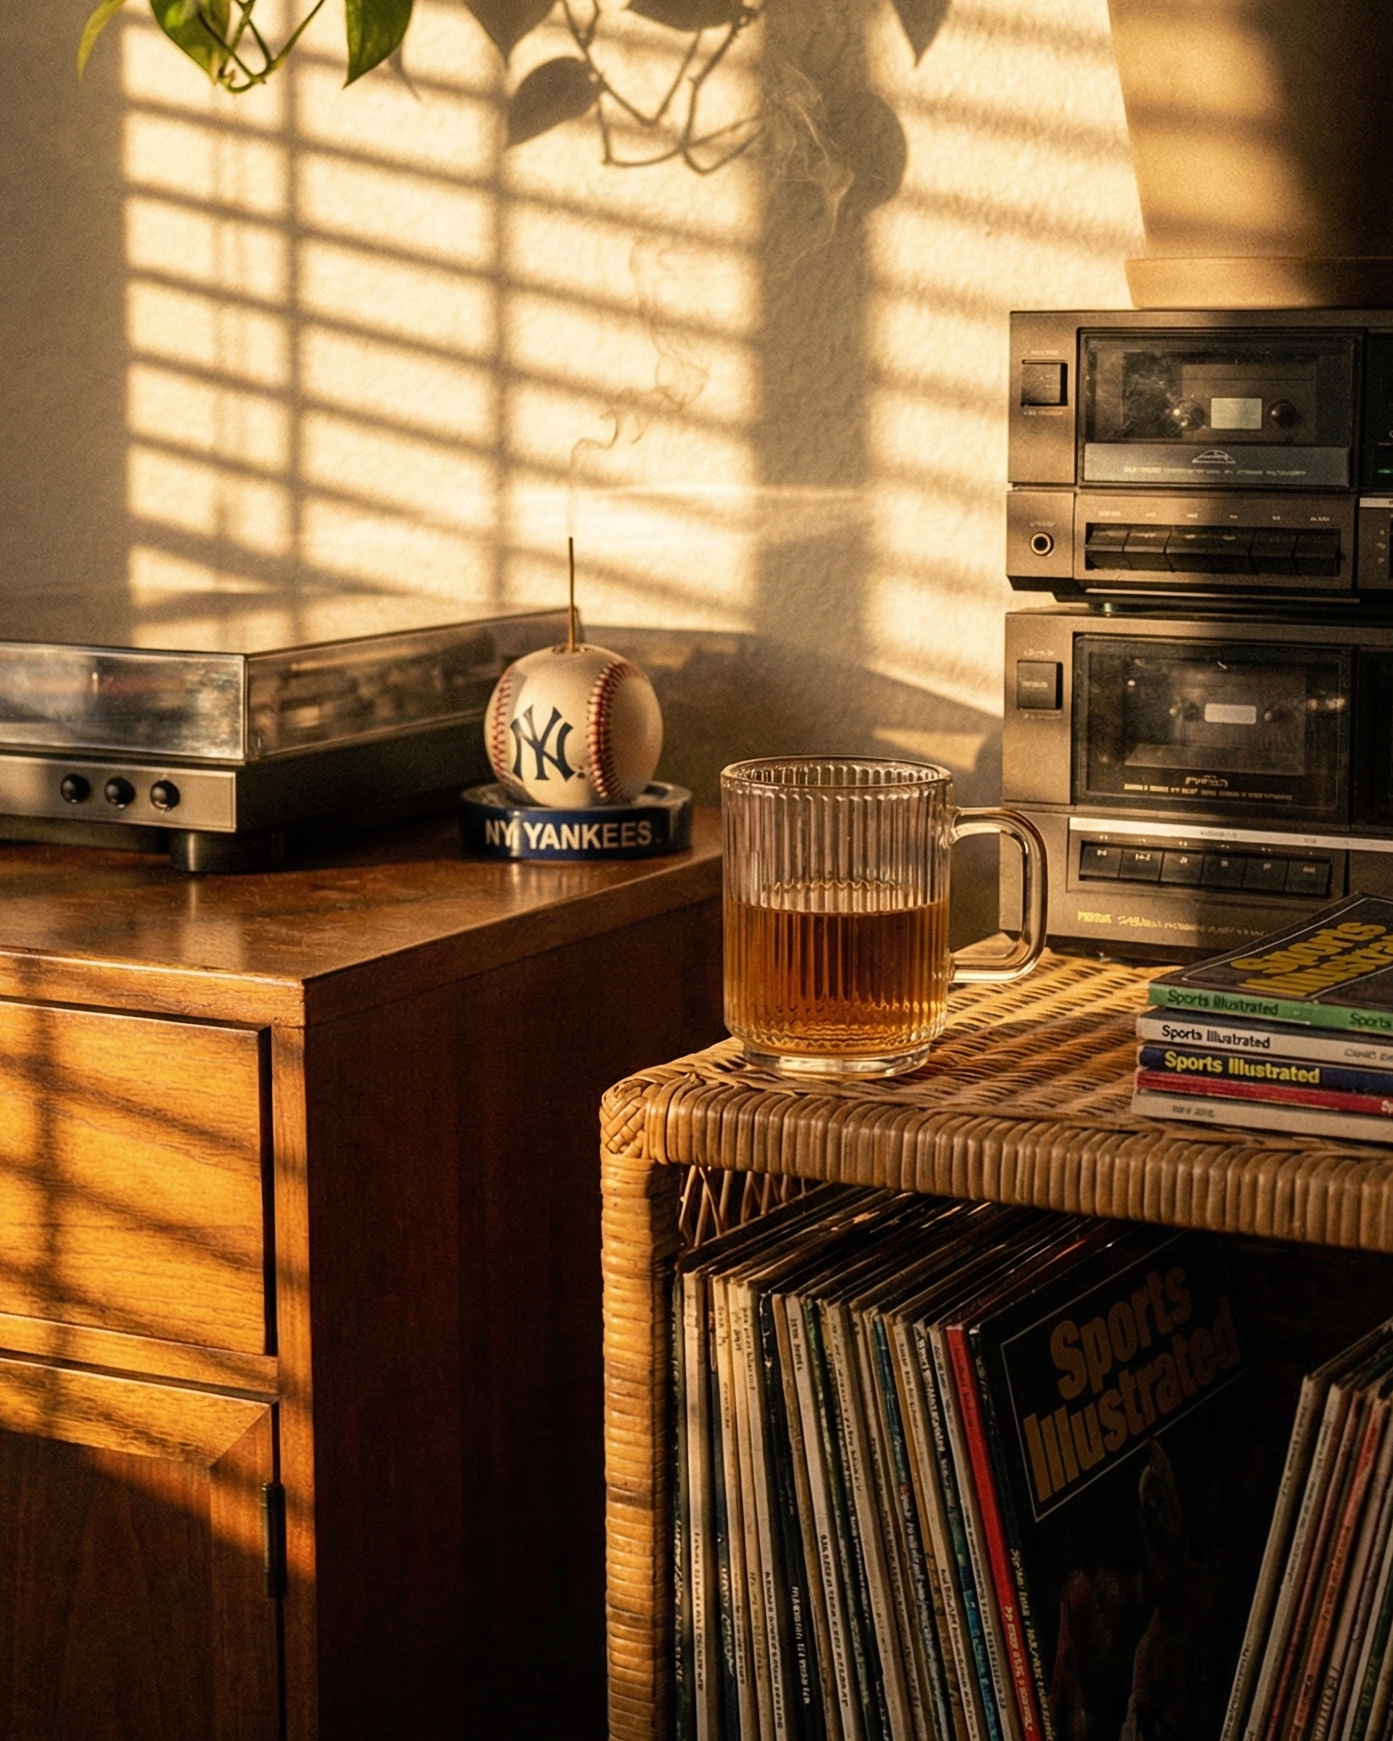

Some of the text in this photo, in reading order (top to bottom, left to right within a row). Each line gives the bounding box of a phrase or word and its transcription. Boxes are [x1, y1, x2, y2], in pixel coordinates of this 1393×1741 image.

[510, 705, 575, 781] NY
[486, 819, 652, 849] NY YANKEES
[1231, 923, 1386, 975] Sports
[1238, 935, 1393, 996] Illustr
[1168, 990, 1279, 1016] Sports Illustrated
[1206, 1030, 1270, 1048] Illustrated
[1165, 1051, 1320, 1083] Sports Illustrated
[1051, 1266, 1192, 1400] Sports
[1022, 1297, 1241, 1503] Illustrated
